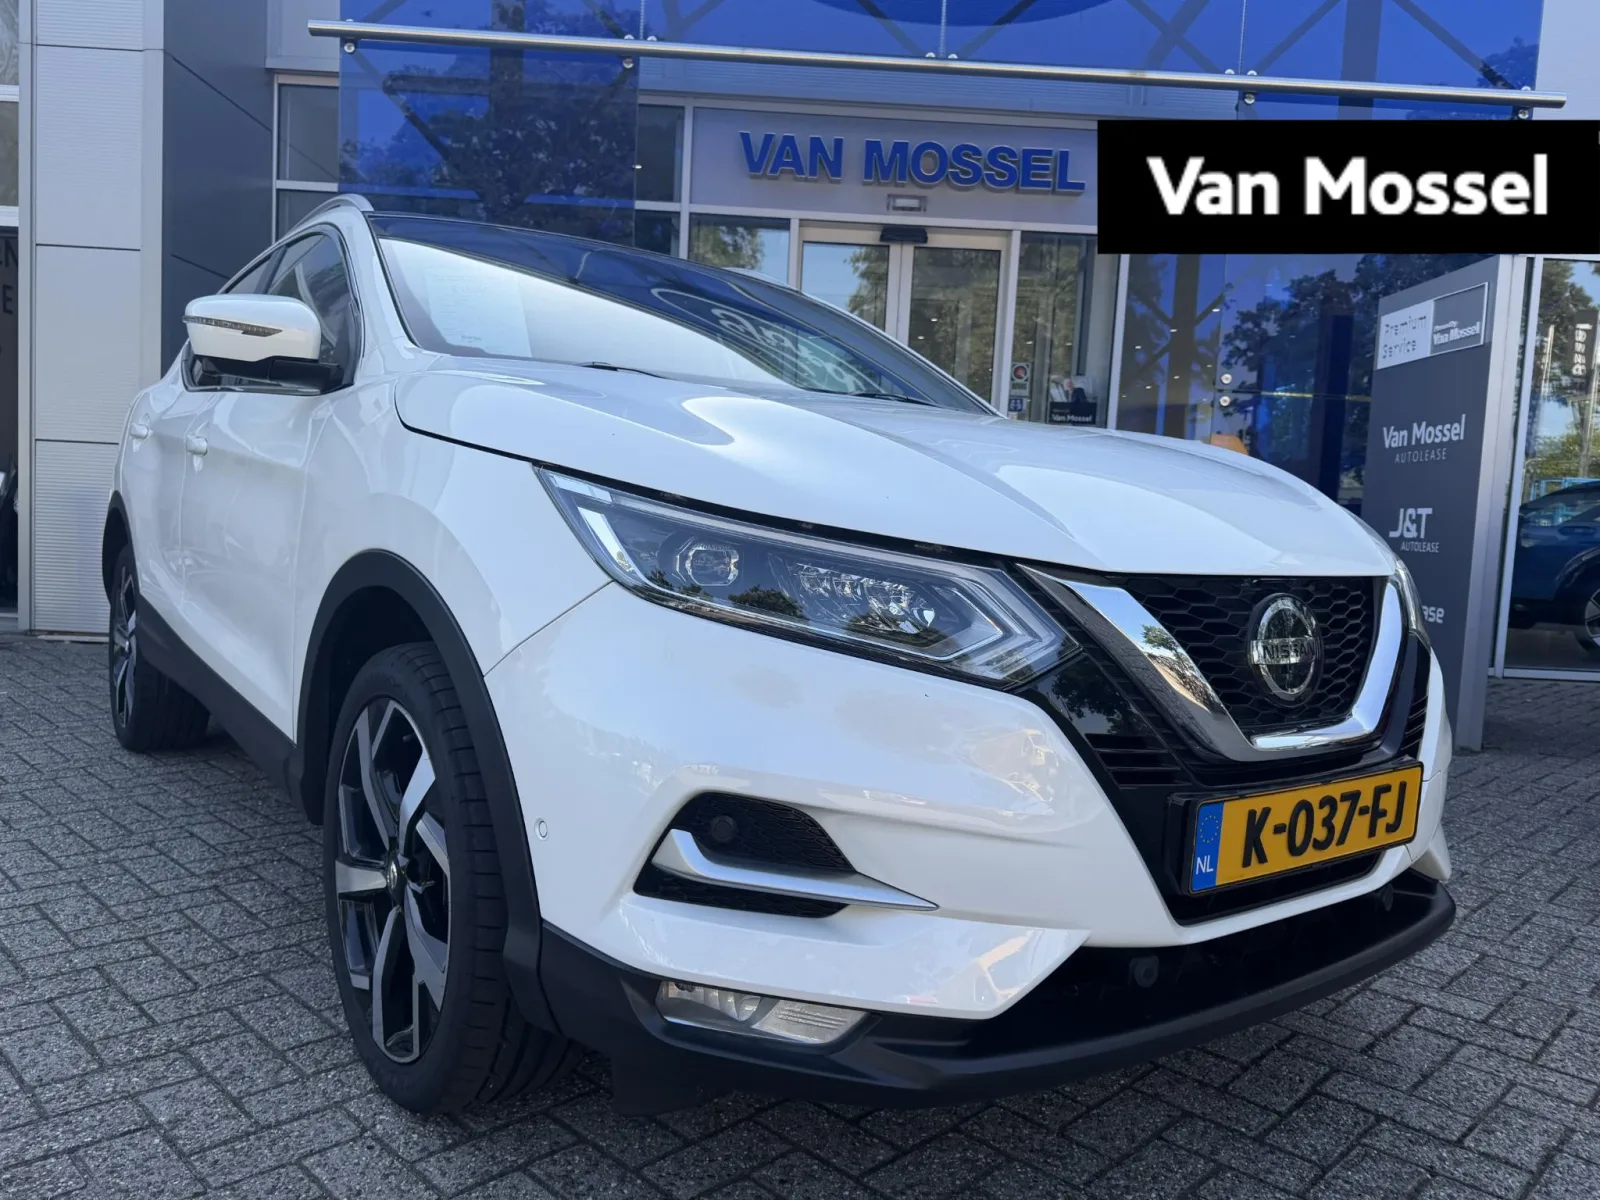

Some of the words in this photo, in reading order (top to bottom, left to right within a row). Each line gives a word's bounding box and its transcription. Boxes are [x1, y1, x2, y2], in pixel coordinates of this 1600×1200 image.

[738, 131, 844, 182] VAN
[863, 138, 1087, 194] MOSSEL
[1384, 314, 1427, 339] Premium
[1433, 333, 1449, 346] Van
[1449, 321, 1480, 341] Mossel
[1382, 338, 1416, 358] Service
[1051, 413, 1066, 422] Van
[1383, 425, 1408, 449] Van
[1412, 413, 1466, 446] Mossel
[1394, 448, 1447, 464] AUTOLEASE
[1388, 507, 1433, 539] J&T
[1400, 541, 1440, 553] AUTOLEASE
[1262, 641, 1316, 660] NISSAN
[1241, 780, 1408, 868] K-037-FJ
[1195, 854, 1215, 875] NL
